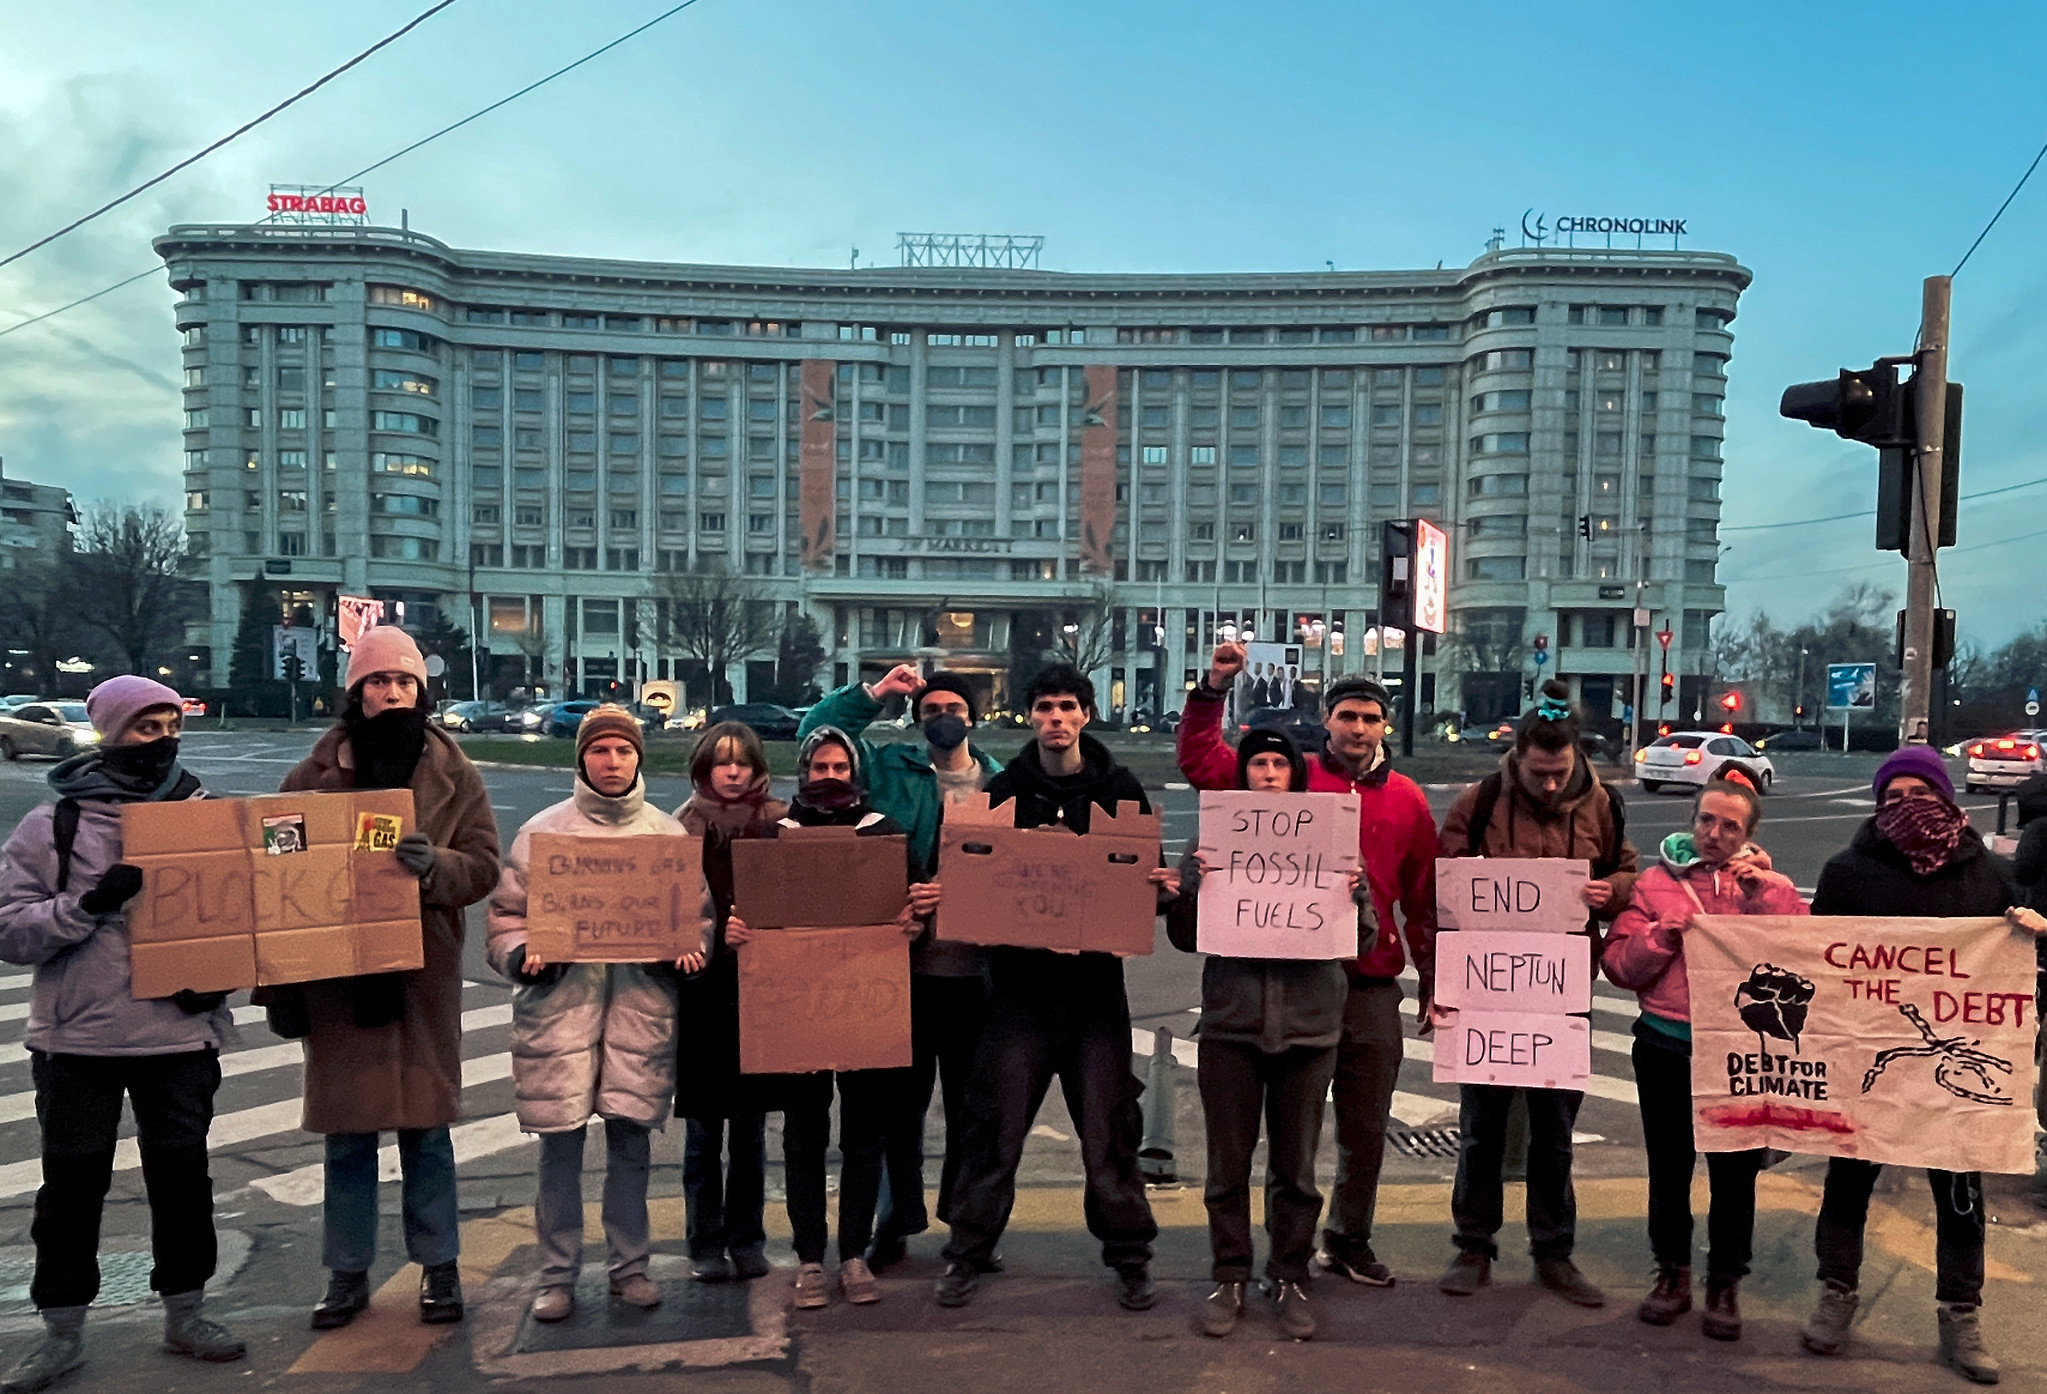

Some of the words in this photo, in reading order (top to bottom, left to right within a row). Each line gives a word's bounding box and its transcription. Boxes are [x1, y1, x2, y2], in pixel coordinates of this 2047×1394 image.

[267, 193, 367, 215] STRABAG
[1556, 216, 1687, 234] CHRONOLINK
[373, 831, 396, 849] GAS
[1231, 809, 1314, 837] STOP
[1230, 850, 1330, 889] FOSSIL
[151, 866, 320, 929] BLOCK
[1471, 876, 1541, 913] END
[1236, 899, 1324, 930] FUELS
[1466, 952, 1566, 995] NEPTUN
[1824, 942, 1971, 979] CANCEL
[1843, 979, 1902, 1006] THE
[1933, 990, 2034, 1028] DEBT
[1466, 1028, 1554, 1067] DEEP
[1726, 1052, 1789, 1077] DEBT
[1789, 1061, 1827, 1078] FOR
[1729, 1075, 1829, 1101] CLIMATE
